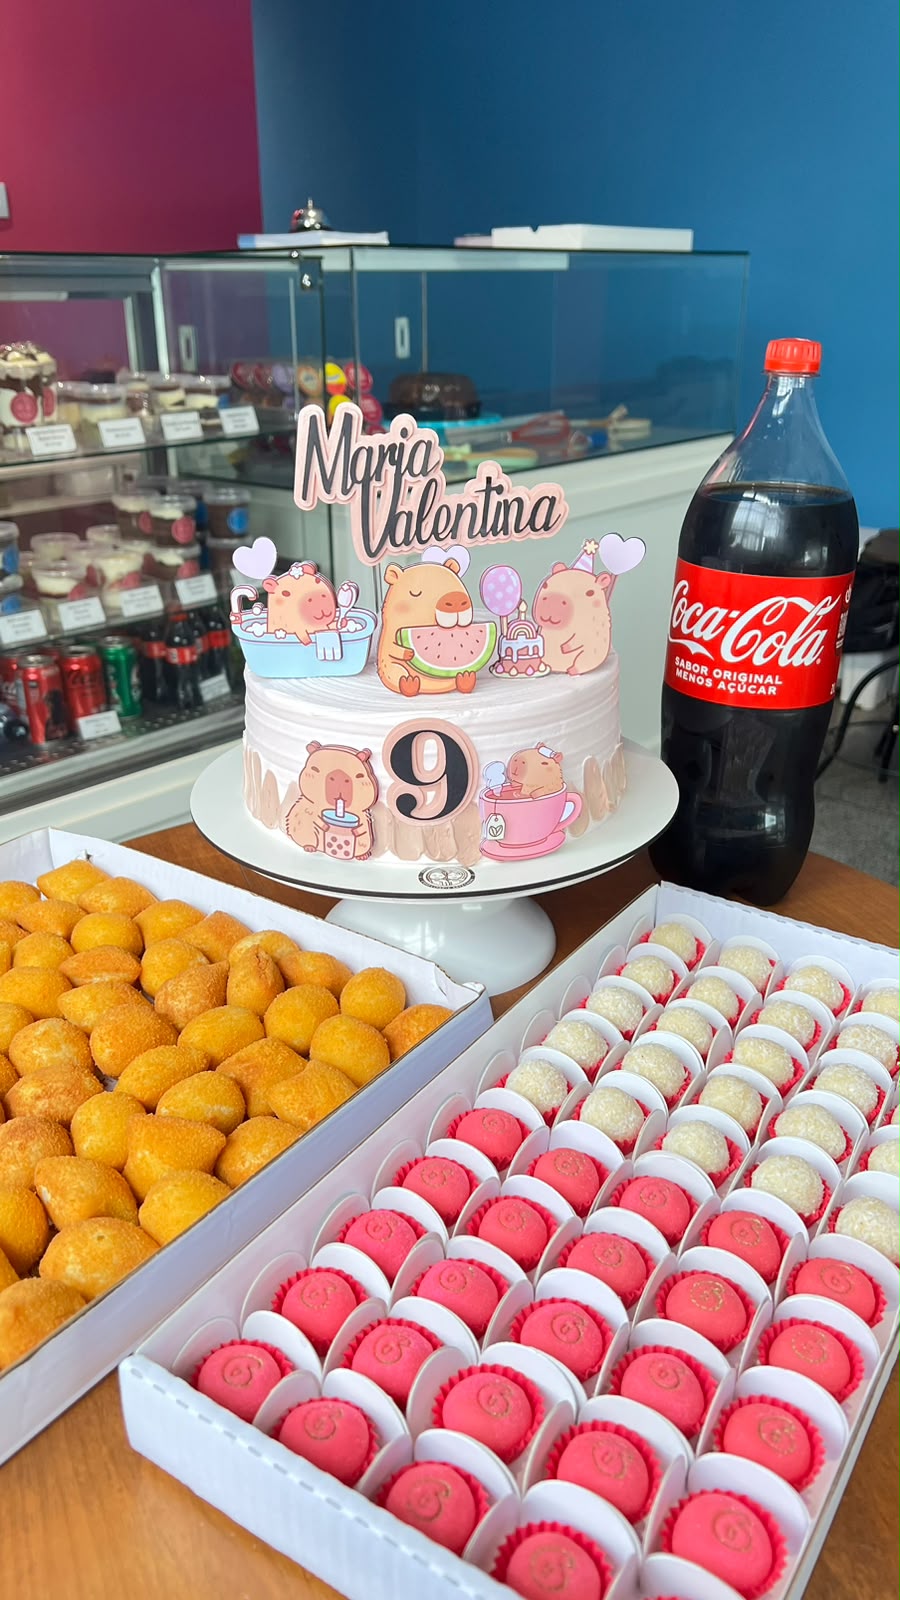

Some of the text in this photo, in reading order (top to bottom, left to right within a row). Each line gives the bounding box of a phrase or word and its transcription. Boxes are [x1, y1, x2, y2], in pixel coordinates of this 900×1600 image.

[302, 412, 441, 502] Maria
[361, 474, 562, 558] Valentina
[668, 580, 842, 667] Coca-Cola
[674, 656, 783, 685] SABOR ORIGINAL
[675, 669, 778, 696] MENOS AÇÚCAR
[390, 729, 469, 820] 9
